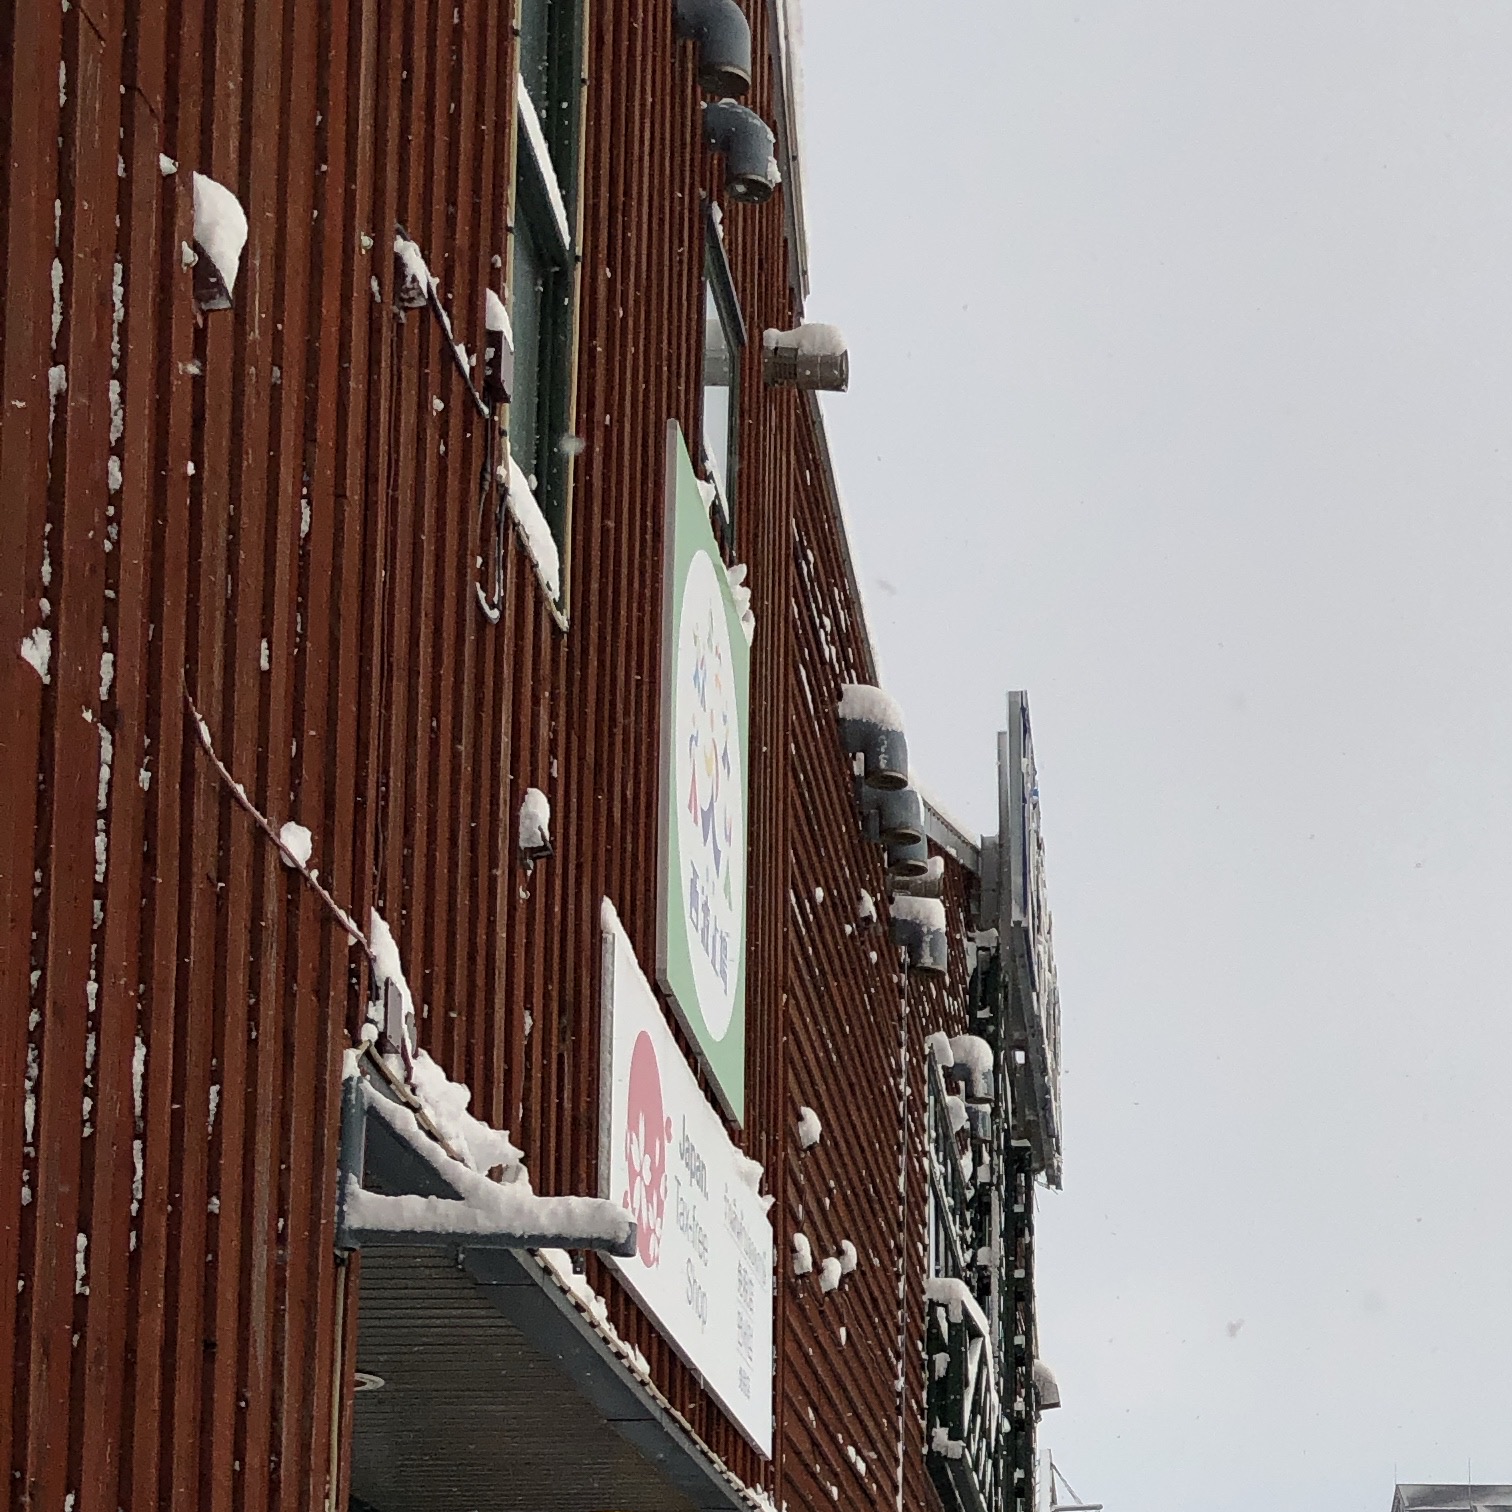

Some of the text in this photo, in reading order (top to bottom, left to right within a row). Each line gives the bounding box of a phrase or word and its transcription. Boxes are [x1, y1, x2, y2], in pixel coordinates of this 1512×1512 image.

[678, 1113, 709, 1201] Japan.
[674, 1173, 709, 1268] Tax-free
[685, 1256, 709, 1335] Shop
